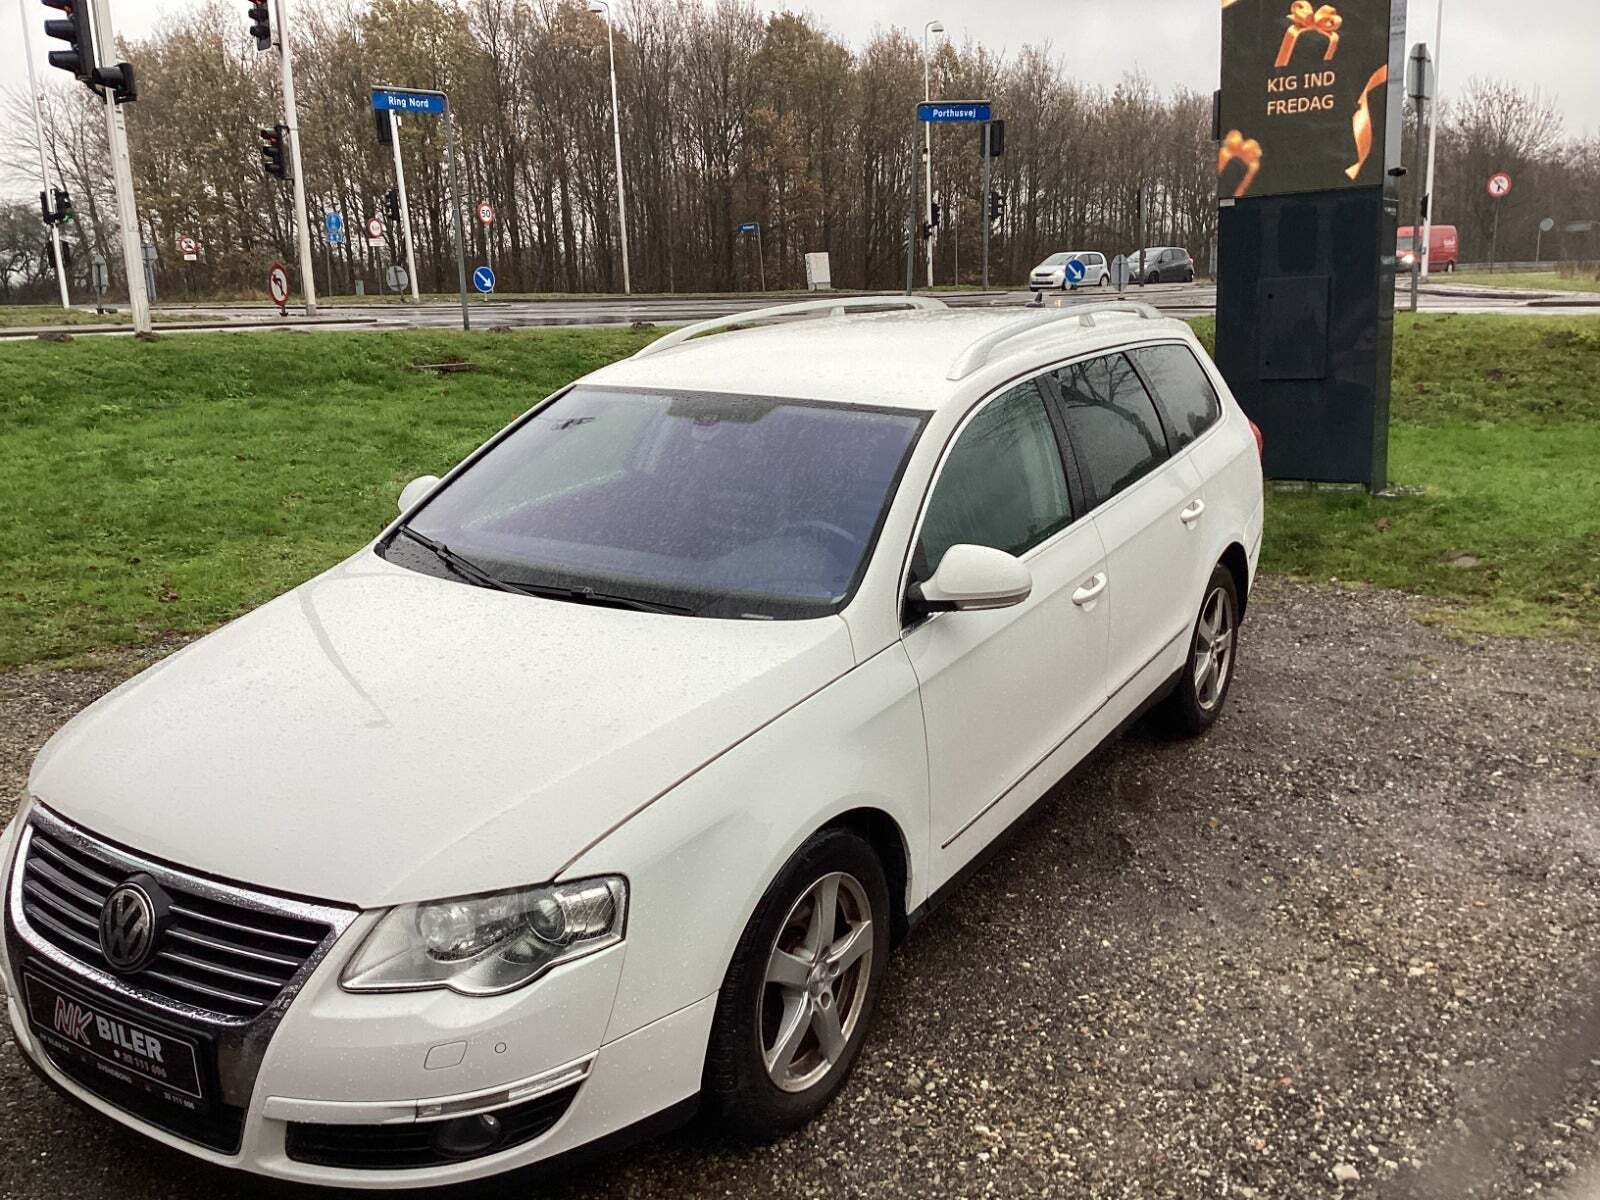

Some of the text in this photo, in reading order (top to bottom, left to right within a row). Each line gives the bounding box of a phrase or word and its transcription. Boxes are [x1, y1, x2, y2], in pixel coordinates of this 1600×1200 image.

[1267, 71, 1335, 93] KIG IND
[388, 96, 429, 108] Ring Nord
[1267, 94, 1334, 116] FREDAG
[932, 108, 976, 118] Porthusvej
[481, 209, 491, 218] 50
[54, 995, 93, 1046] NK
[96, 1014, 164, 1063] BILER
